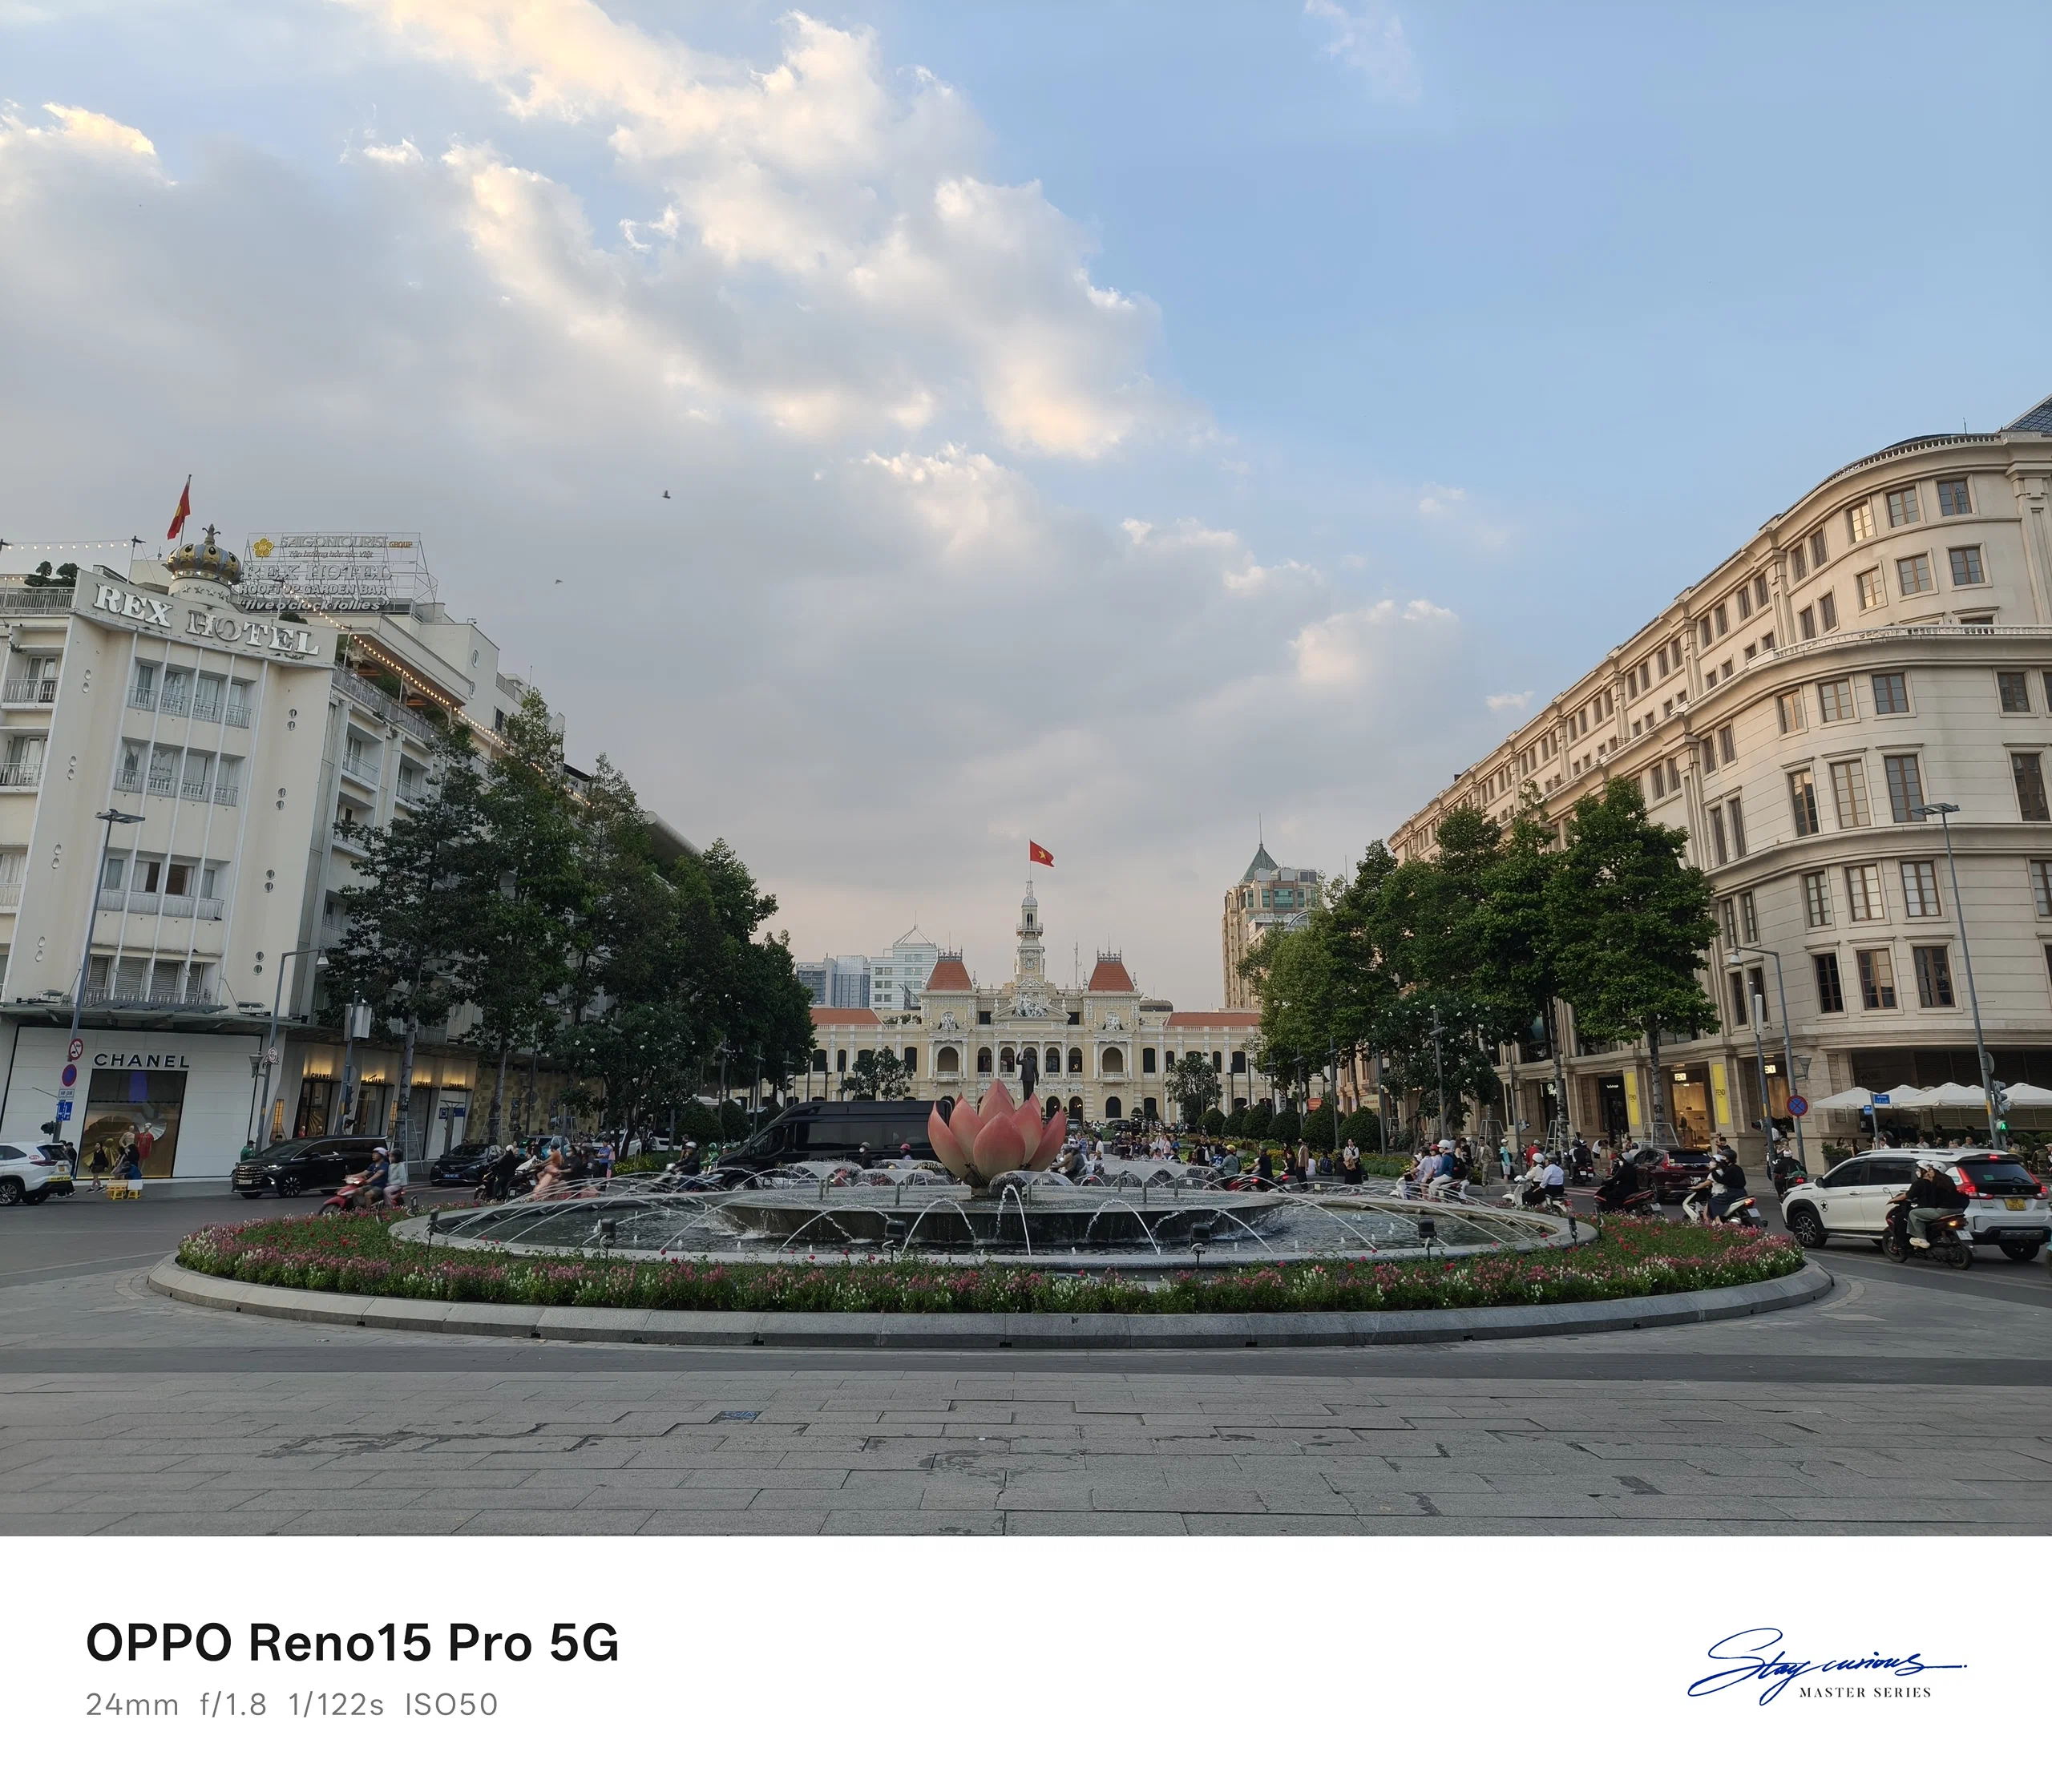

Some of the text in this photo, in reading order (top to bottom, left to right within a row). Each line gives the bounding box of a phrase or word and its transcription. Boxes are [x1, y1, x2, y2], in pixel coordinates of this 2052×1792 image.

[281, 535, 388, 547] SAIGONTOURIST
[241, 564, 392, 580] REX HOTEL
[240, 584, 387, 595] ROOFTOP GARDEN BAR
[93, 583, 320, 656] REX HOTEL
[94, 1053, 190, 1068] CHANEL
